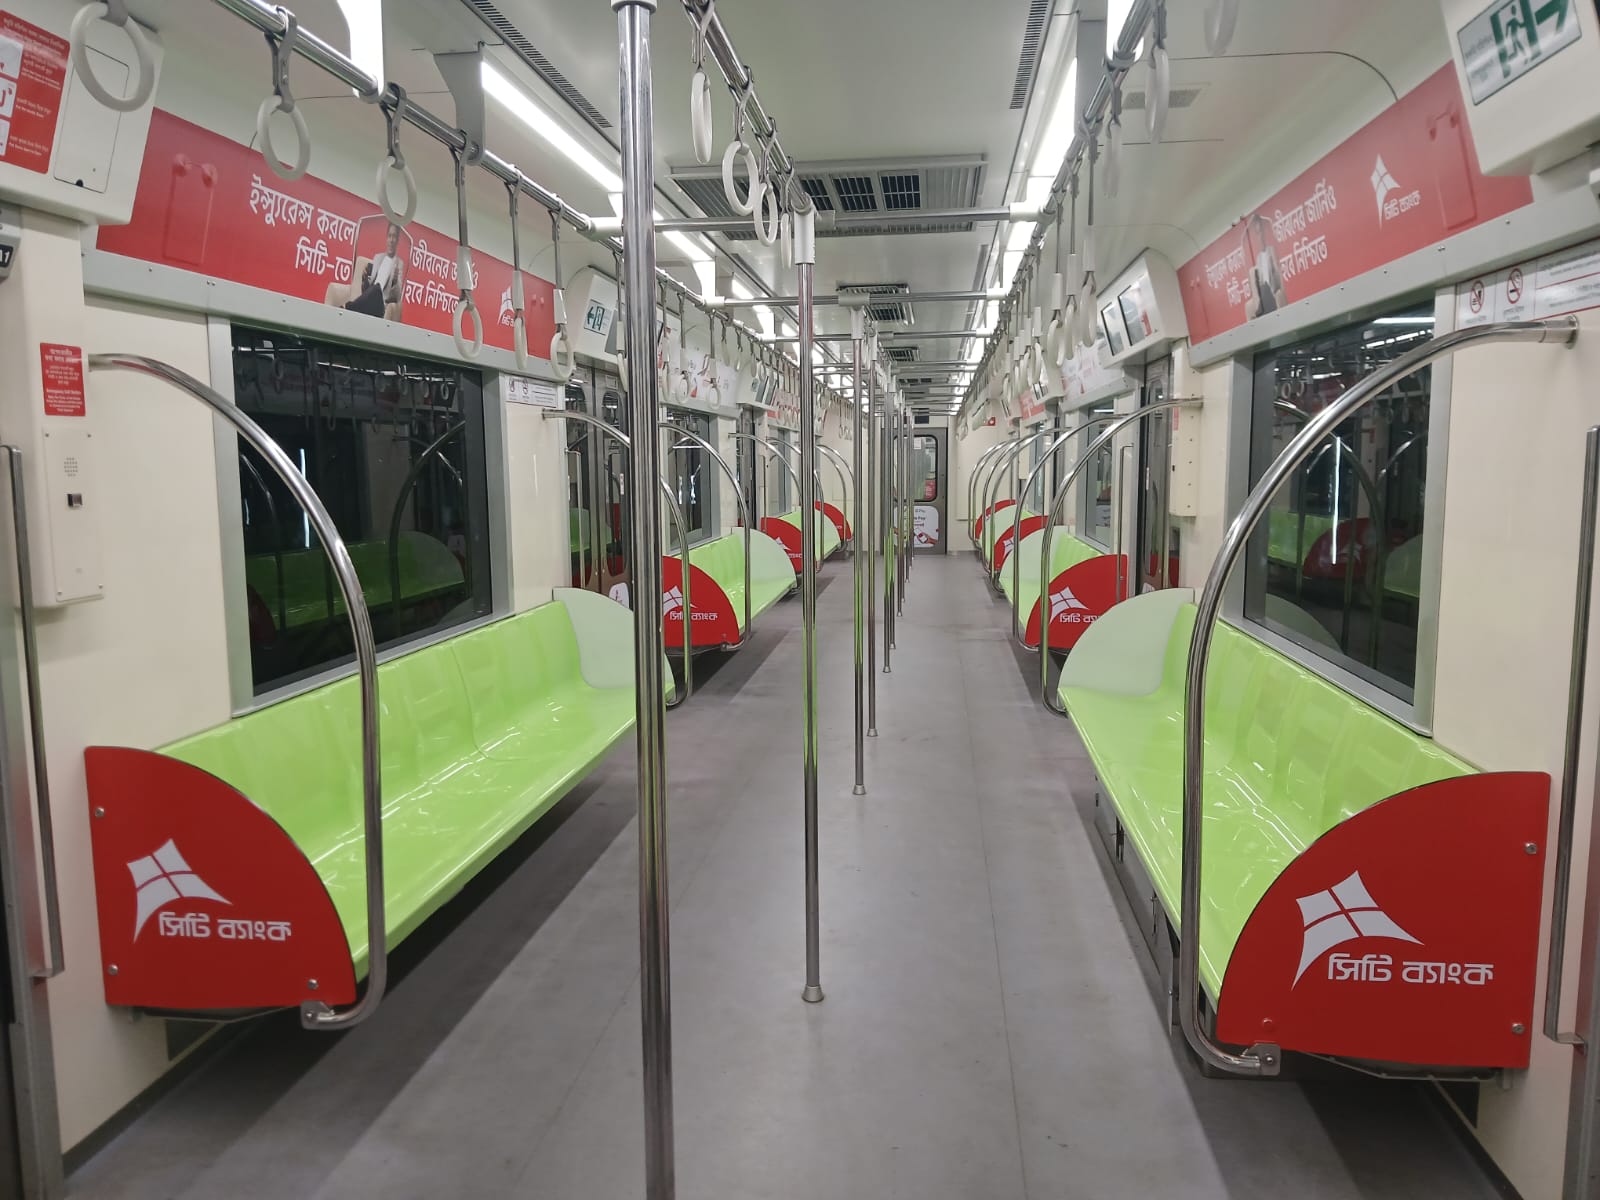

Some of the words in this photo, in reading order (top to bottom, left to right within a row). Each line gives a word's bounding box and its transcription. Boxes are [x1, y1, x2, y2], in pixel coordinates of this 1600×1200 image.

[317, 207, 357, 245] করলে
[295, 236, 353, 281] সিটি-তে
[411, 239, 450, 280] জীবনের
[404, 280, 424, 305] হবে
[158, 911, 211, 938] সিটি
[217, 919, 292, 941] ব্যাংক
[1327, 952, 1393, 982] সিটি
[1401, 961, 1494, 985] ব্যাংক
